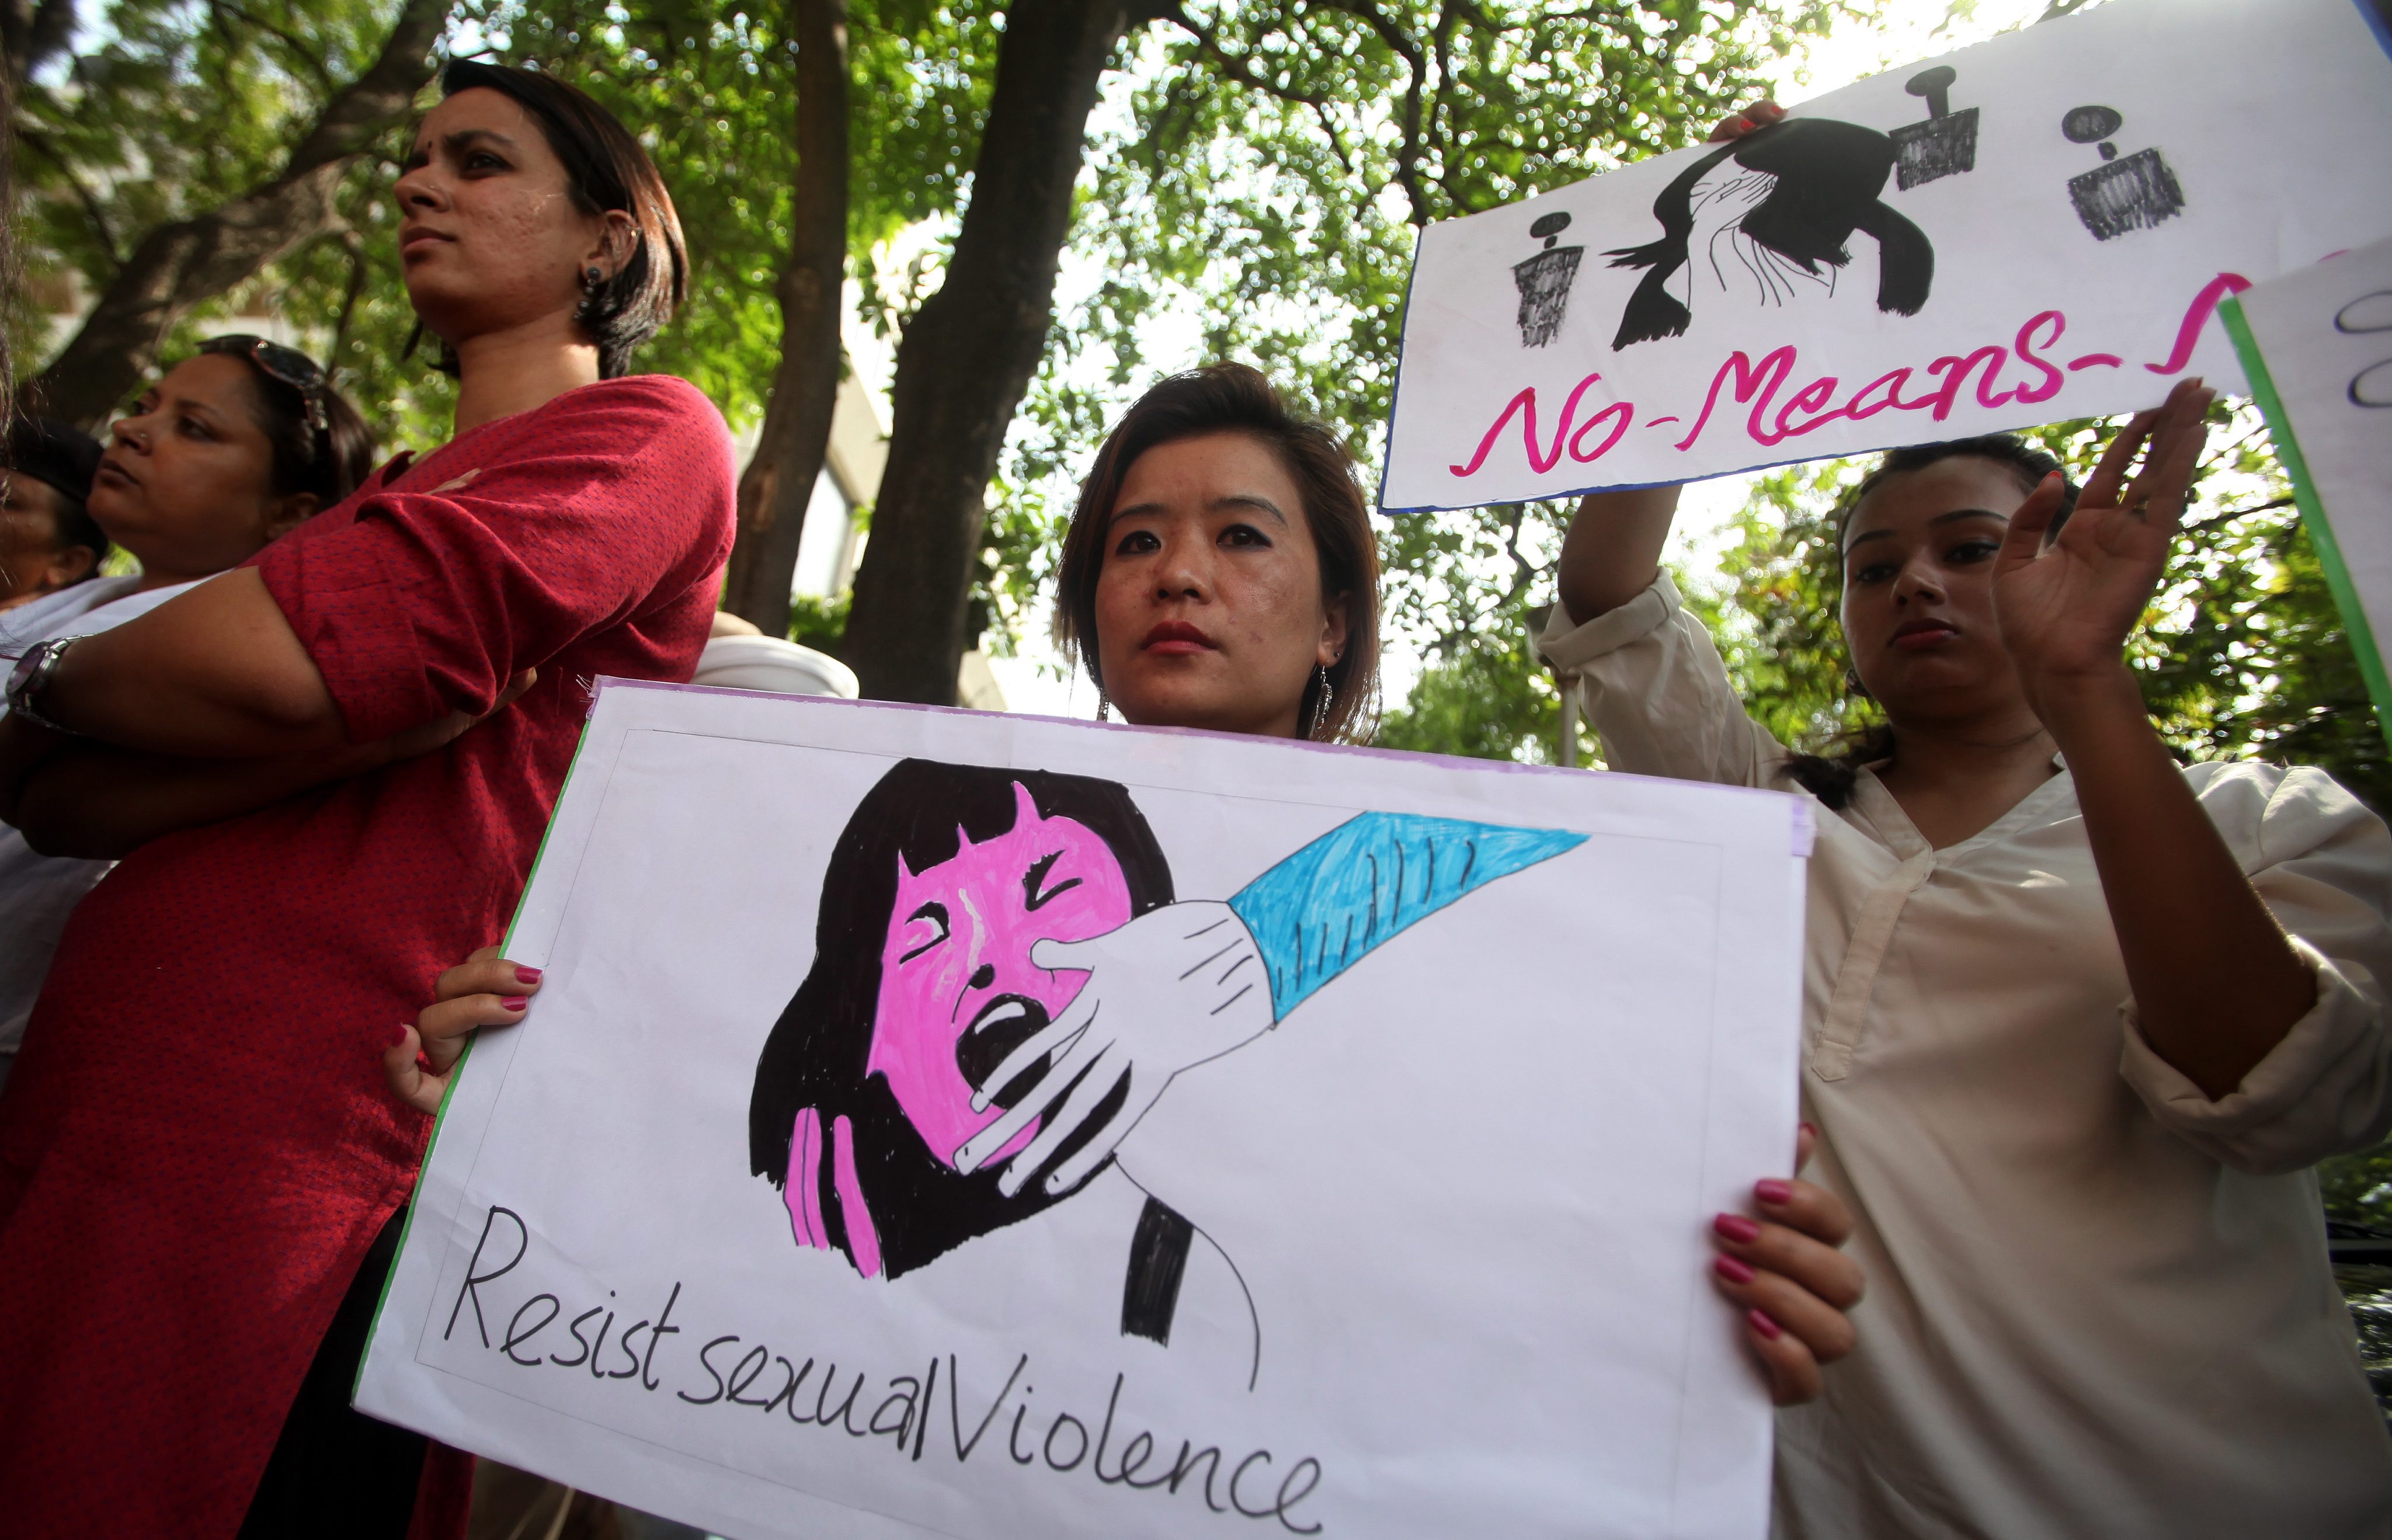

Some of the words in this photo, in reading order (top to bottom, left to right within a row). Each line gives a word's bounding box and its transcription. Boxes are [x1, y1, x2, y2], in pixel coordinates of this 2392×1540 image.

[444, 1205, 682, 1392] Resist
[676, 1334, 939, 1462] sexual
[950, 1353, 1322, 1535] Violence
